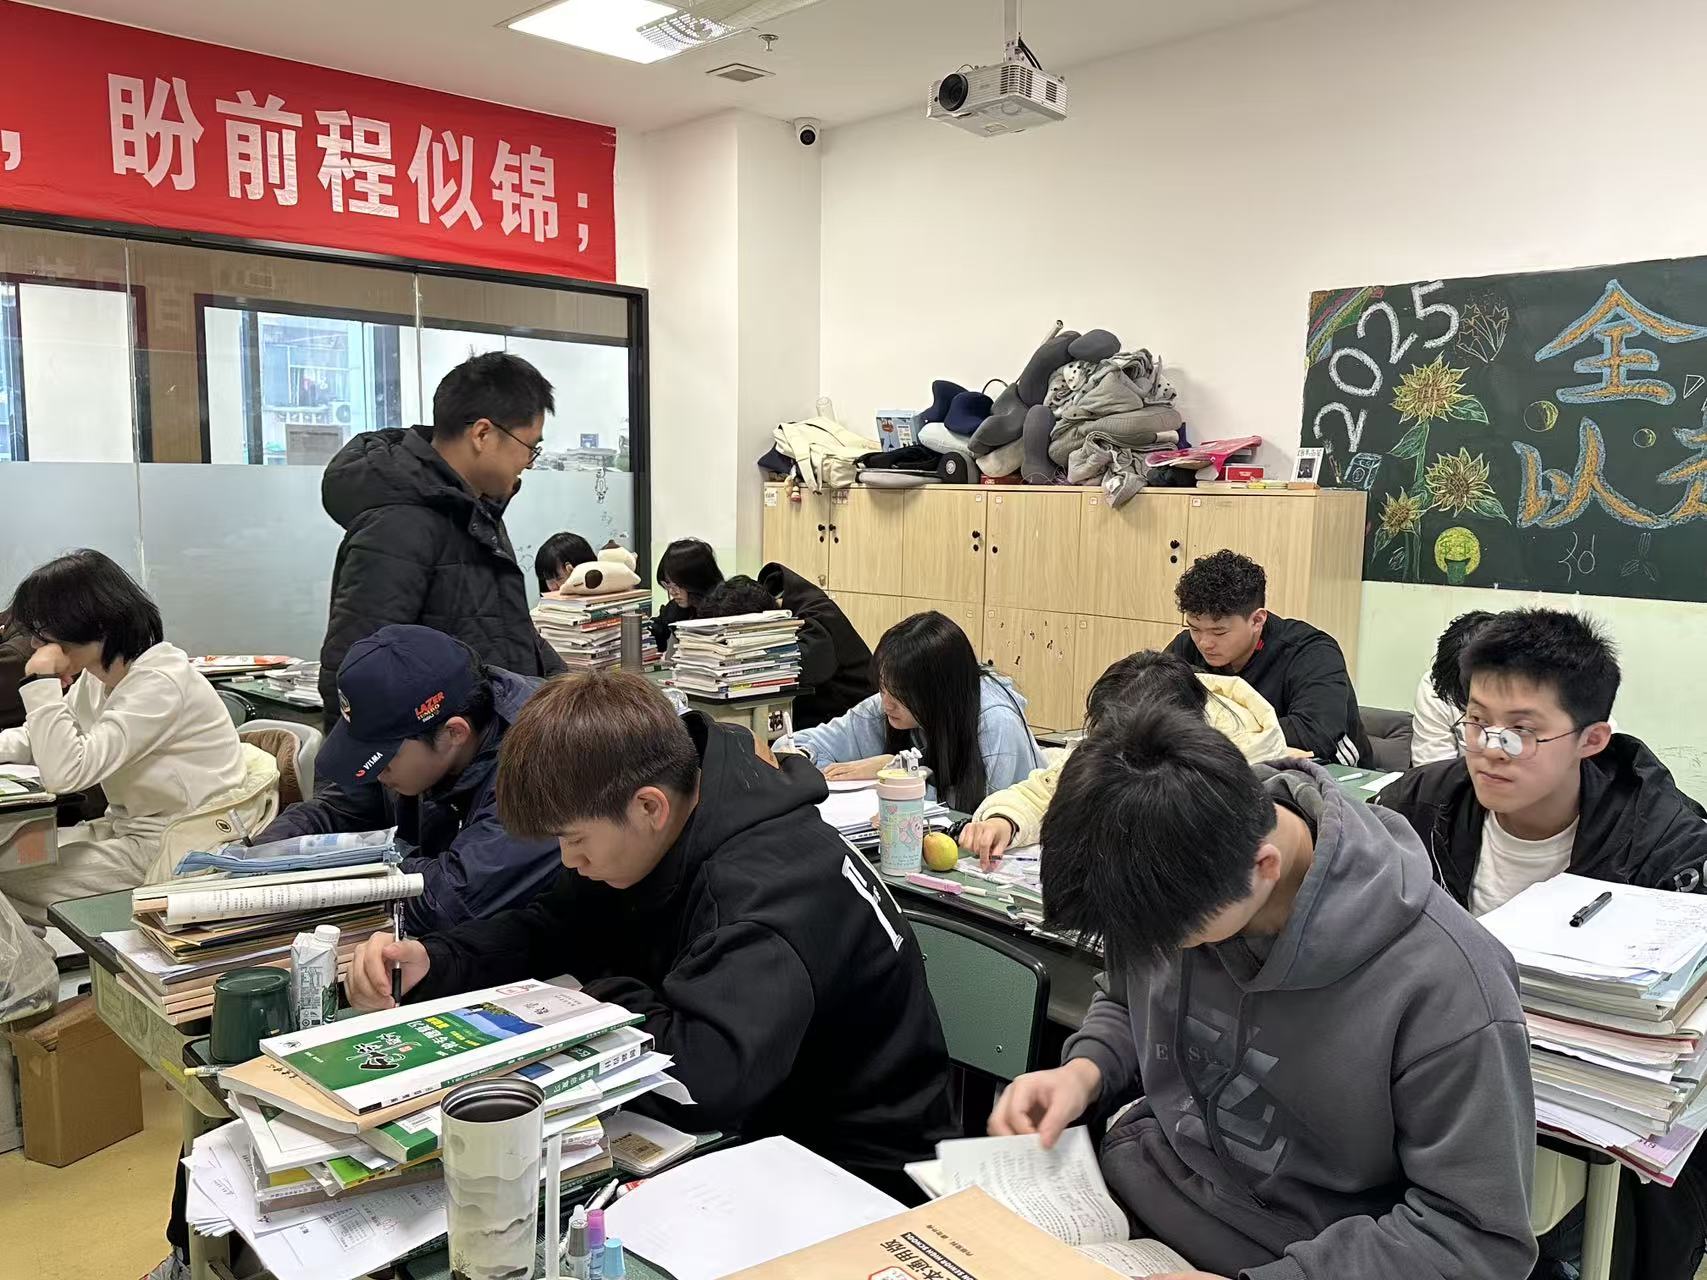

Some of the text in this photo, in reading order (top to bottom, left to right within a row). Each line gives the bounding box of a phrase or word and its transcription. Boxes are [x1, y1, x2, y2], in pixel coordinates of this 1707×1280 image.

[1534, 278, 1707, 406] 全
[1313, 280, 1461, 453] 2025
[363, 751, 383, 770] VISMA
[880, 1239, 951, 1280] 本通用版
[904, 1232, 929, 1251] SCHOOL
